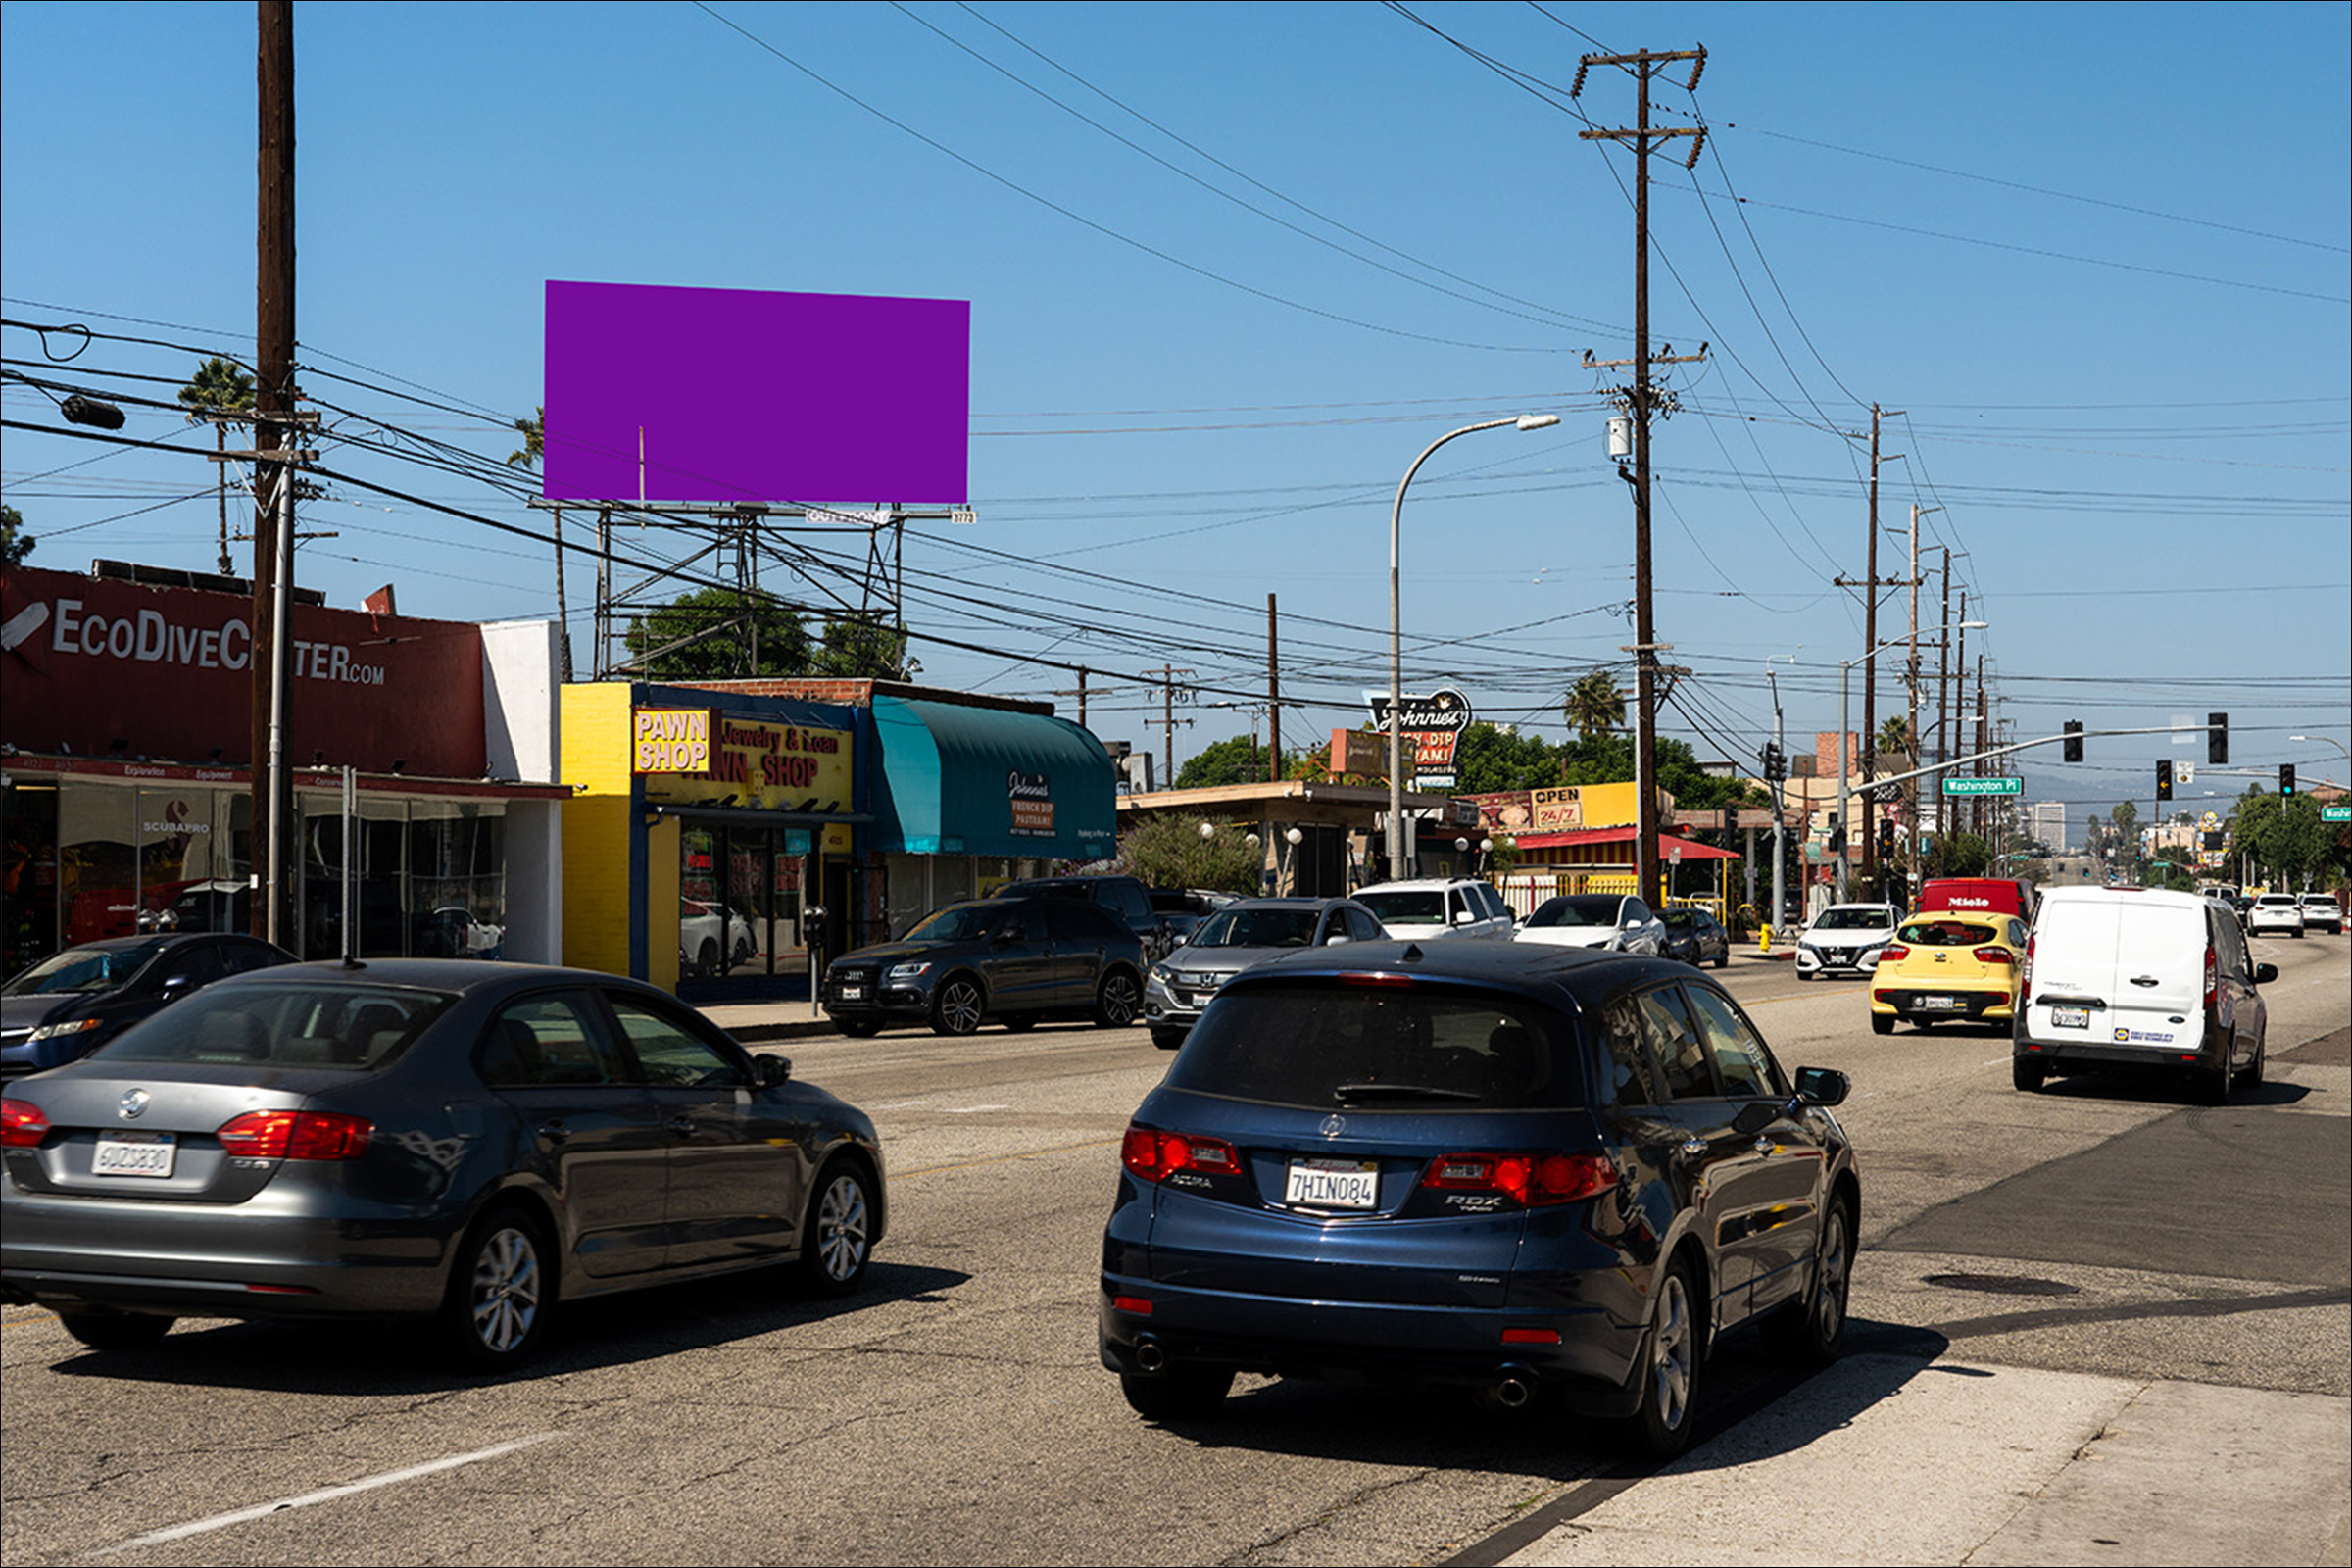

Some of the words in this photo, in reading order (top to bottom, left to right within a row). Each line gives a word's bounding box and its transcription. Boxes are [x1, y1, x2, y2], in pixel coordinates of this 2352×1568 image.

[636, 712, 708, 741] PAWN
[722, 722, 782, 754] Jewelry
[786, 728, 800, 751] &
[803, 728, 840, 755] Loan
[637, 742, 708, 770] SHOP
[195, 769, 233, 780] Equipment
[760, 755, 819, 787] SHOP
[1535, 788, 1580, 803] OPEN
[1948, 781, 2003, 794] Washington
[1540, 806, 1574, 823] 24/7
[143, 820, 210, 834] SCUBAPRO
[1948, 897, 1989, 906] Miele
[1292, 1174, 1371, 1200] 7HIN084
[1445, 1195, 1503, 1206] RDX
